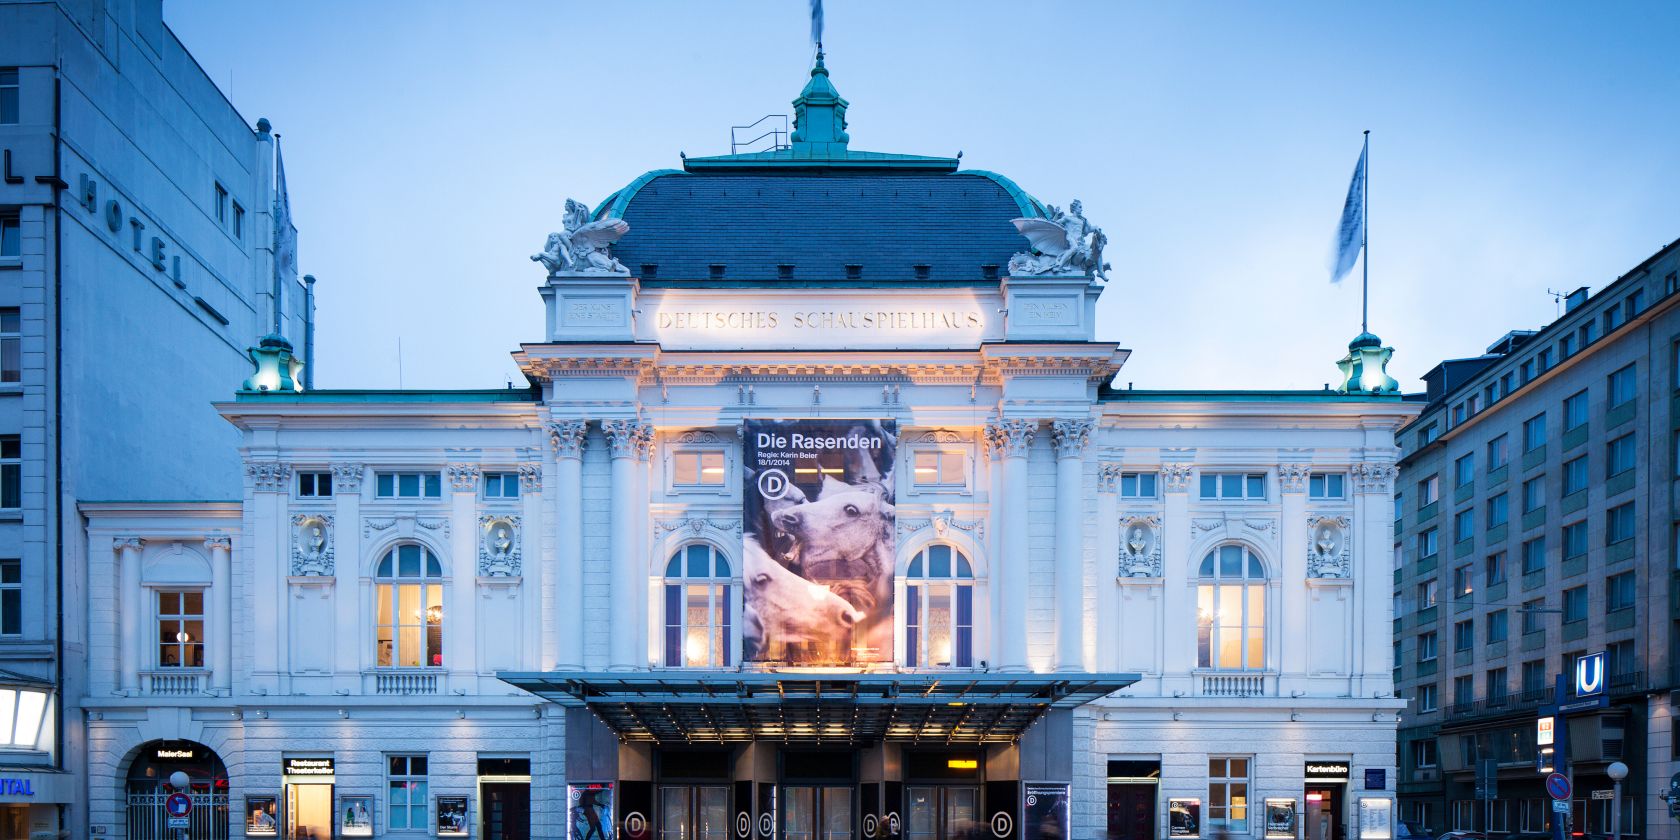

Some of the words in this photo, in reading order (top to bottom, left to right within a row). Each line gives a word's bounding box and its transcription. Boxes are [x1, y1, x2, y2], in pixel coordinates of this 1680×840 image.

[79, 172, 187, 289] HOTEL
[658, 311, 778, 329] DEUTSCHES
[793, 311, 984, 329] SCHAUSPIELHAUS.
[757, 433, 787, 449] Die
[791, 433, 882, 449] Rasenden
[1580, 656, 1601, 693] U
[157, 750, 193, 758] MaierSaal
[290, 759, 330, 767] Restaurant
[1306, 765, 1348, 773] Kartenbüro
[286, 767, 334, 775] Theaterkeller
